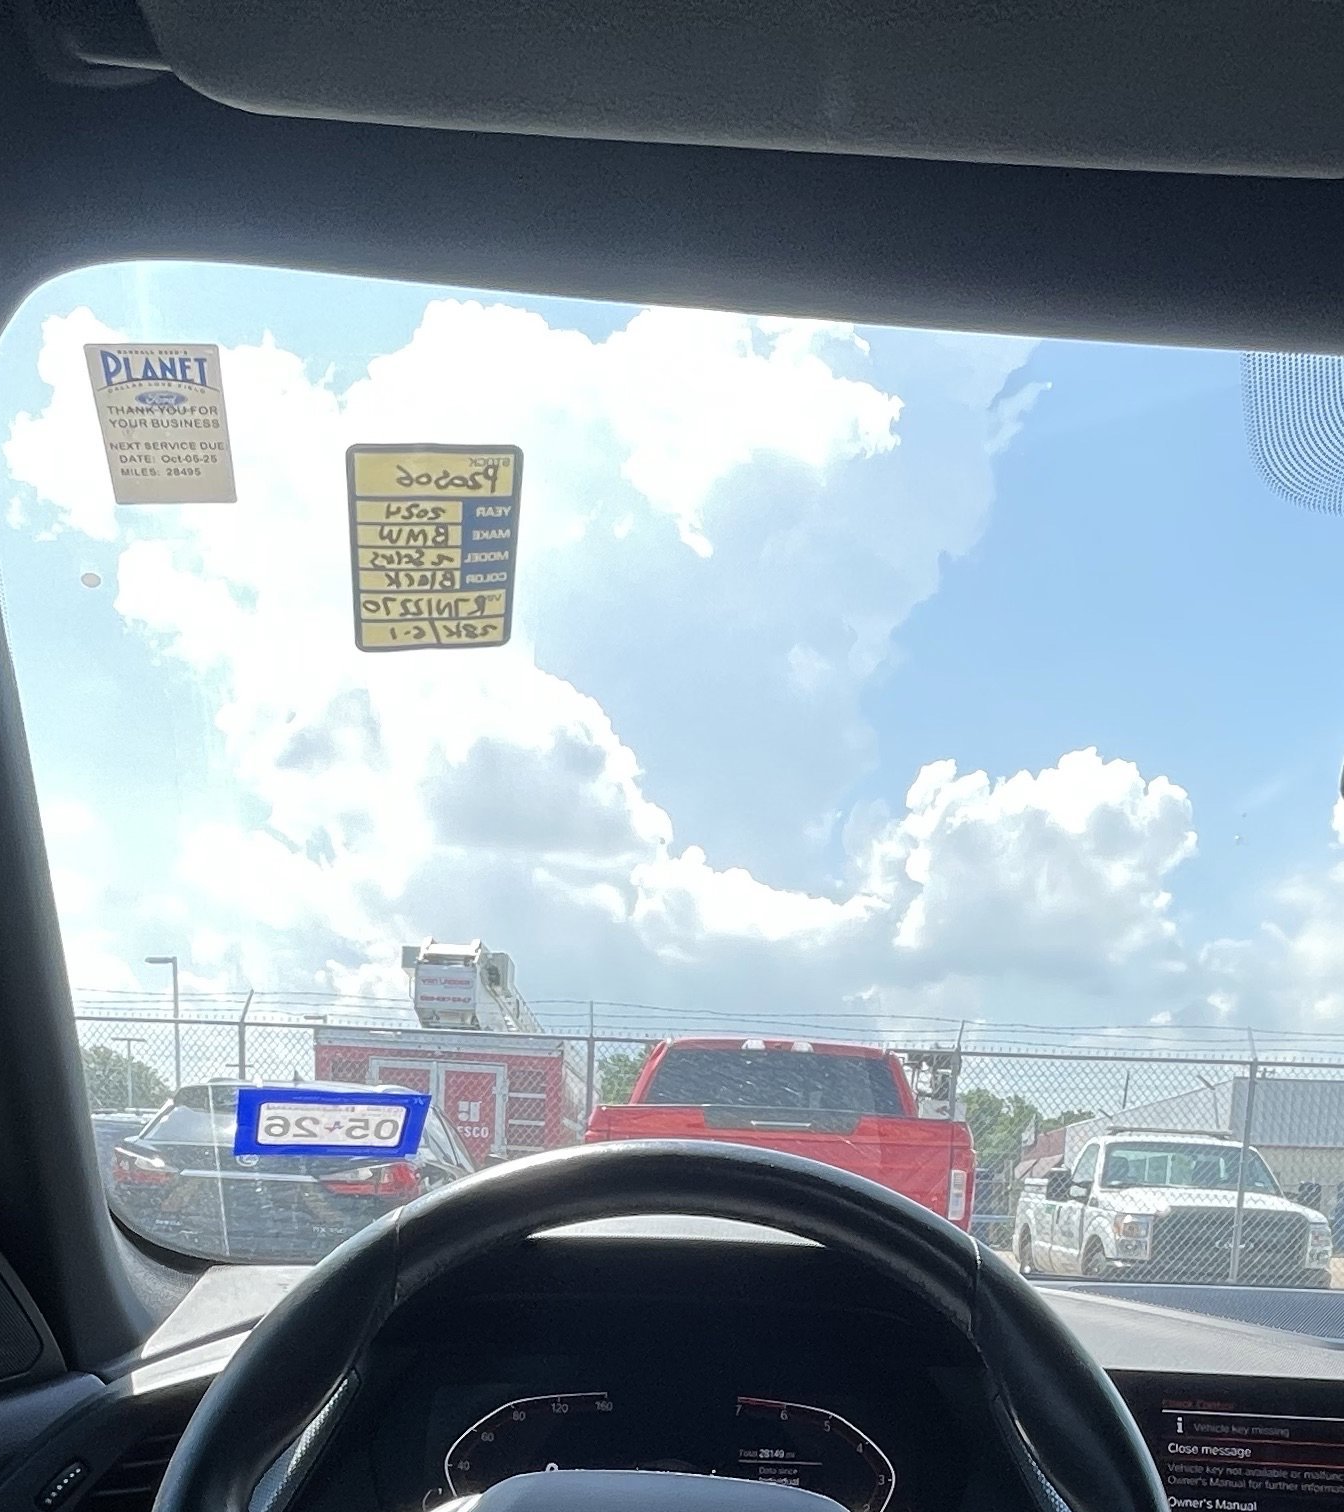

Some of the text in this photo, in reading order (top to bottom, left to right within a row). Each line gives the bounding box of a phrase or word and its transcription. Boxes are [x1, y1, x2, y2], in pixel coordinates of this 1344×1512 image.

[100, 349, 209, 386] PLANET
[106, 405, 219, 416] THANK YOU FOR
[108, 418, 221, 429] YOUR BUSINESS
[109, 441, 225, 451] NEXT SERVICE DUE
[119, 454, 156, 464] DATE:
[121, 467, 161, 477] MILES:
[550, 1402, 569, 1415] 120
[1193, 1422, 1290, 1438] Vehicle key missing
[1167, 1442, 1252, 1458] Close message
[1167, 1462, 1204, 1474] Vehicle
[1206, 1464, 1223, 1476] key
[1209, 1476, 1246, 1489] Manual
[1248, 1478, 1262, 1489] for
[1167, 1496, 1258, 1512] Owner's Manual
